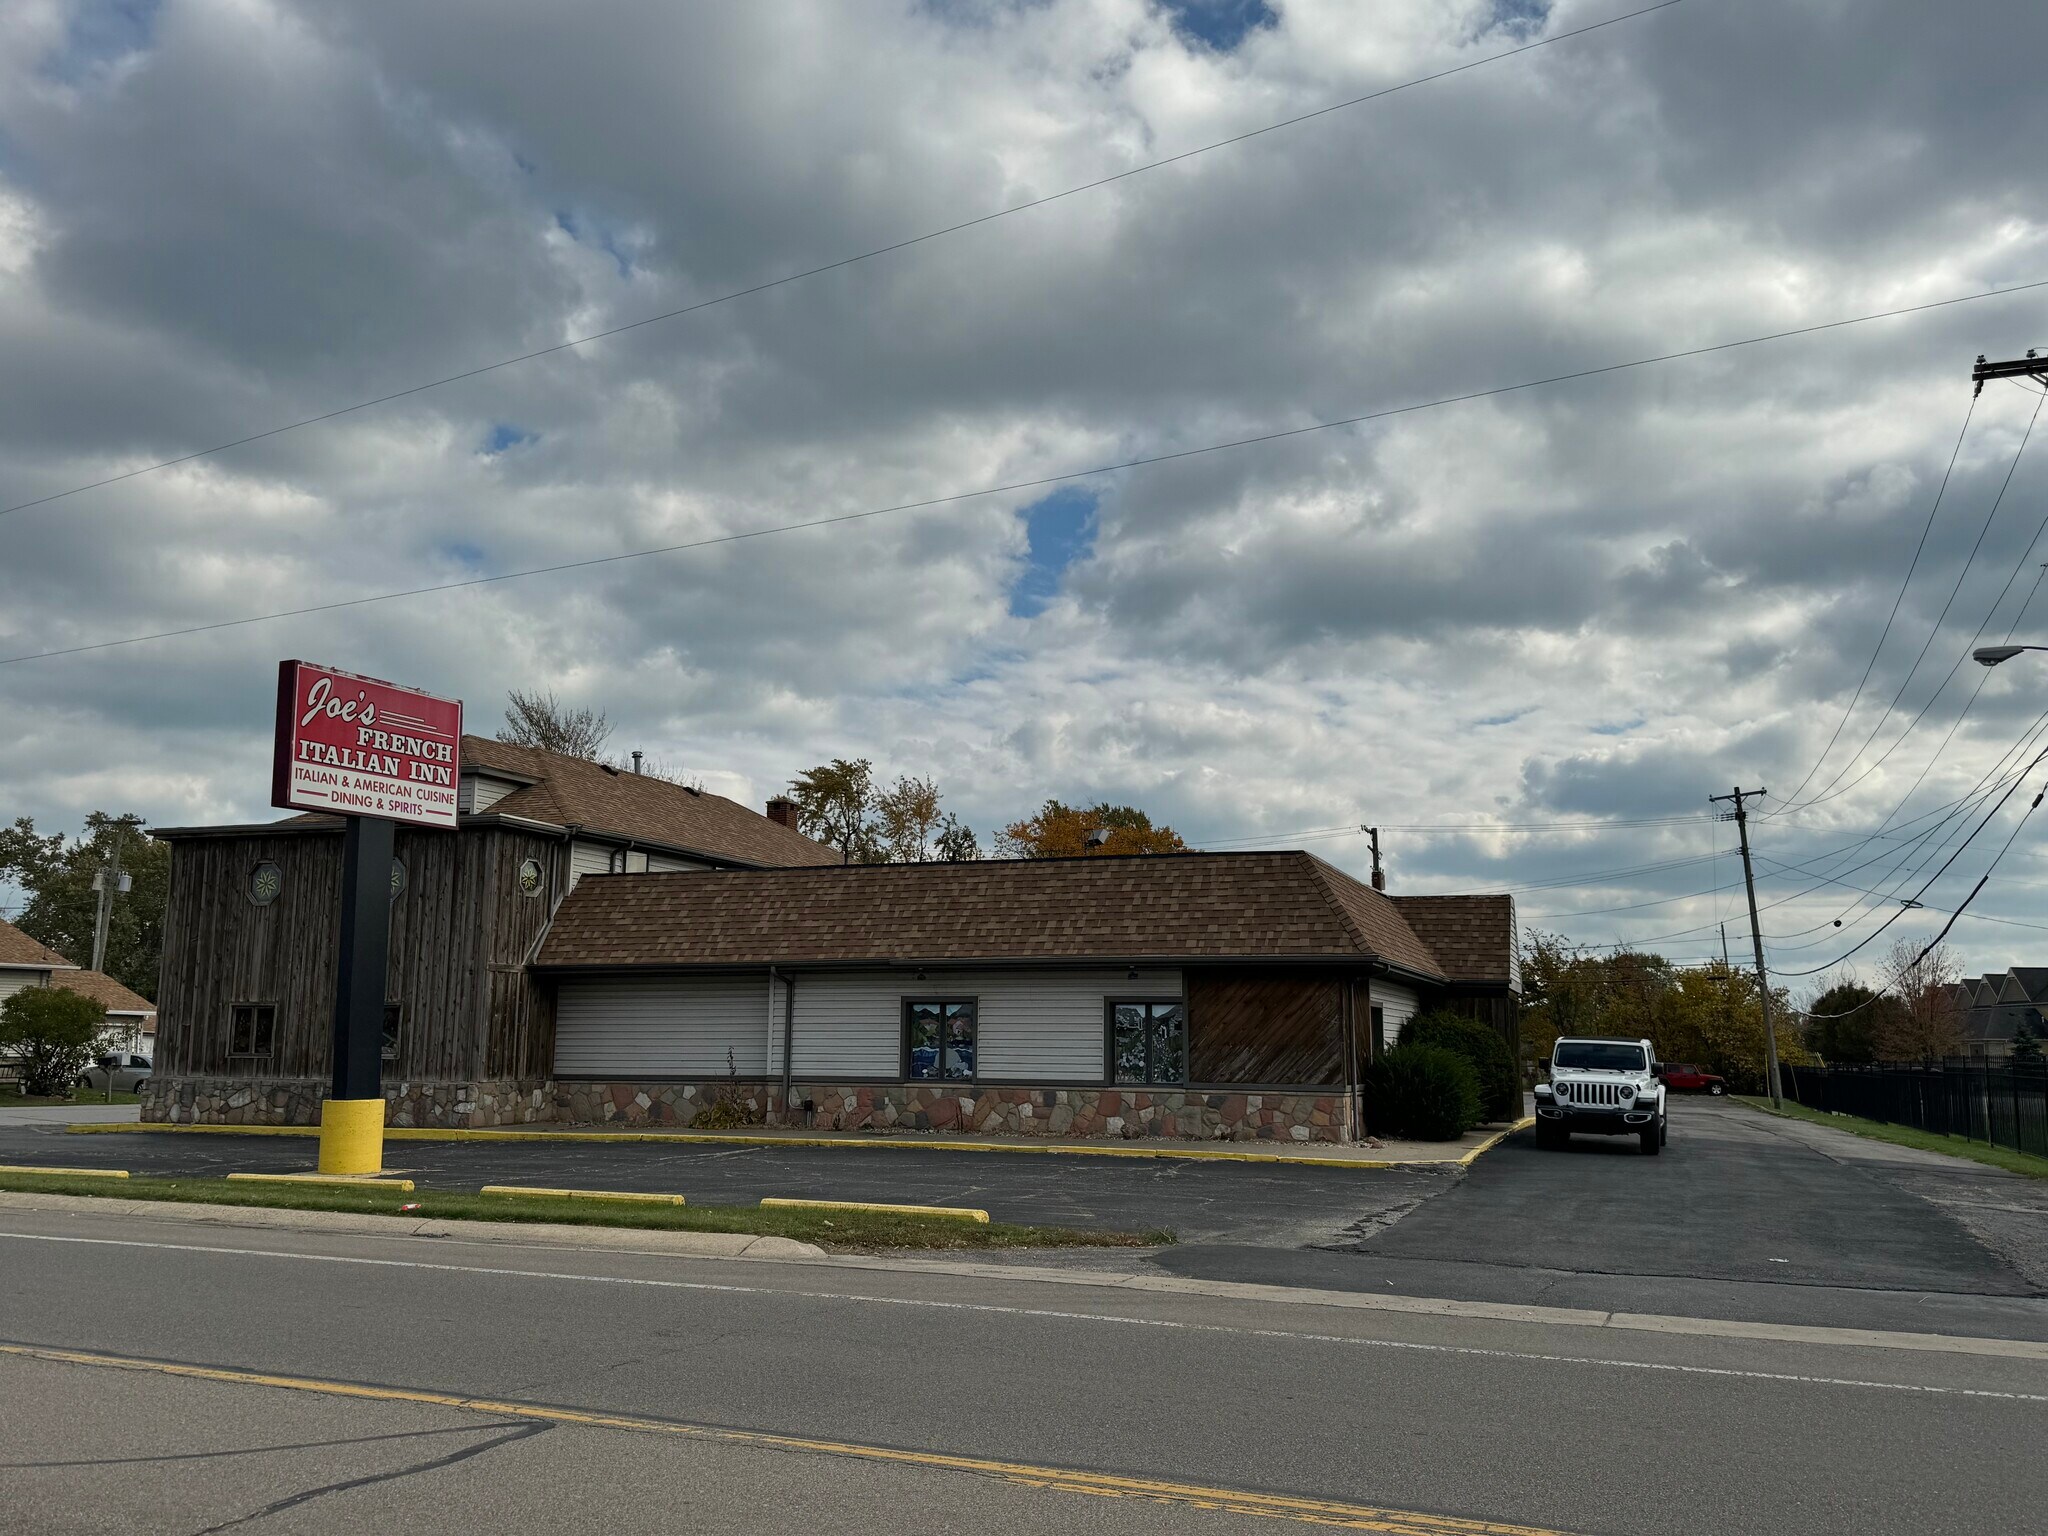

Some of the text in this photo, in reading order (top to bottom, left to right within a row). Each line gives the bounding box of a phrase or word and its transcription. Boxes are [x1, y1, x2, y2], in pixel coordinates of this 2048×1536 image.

[301, 677, 377, 727] Joe's
[299, 739, 453, 786] ITALIAN INN
[356, 726, 453, 763] FRENCH
[295, 767, 455, 805] ITALIAN & AMERICAN CUISINE
[331, 790, 423, 816] DINING & SPIRITS
